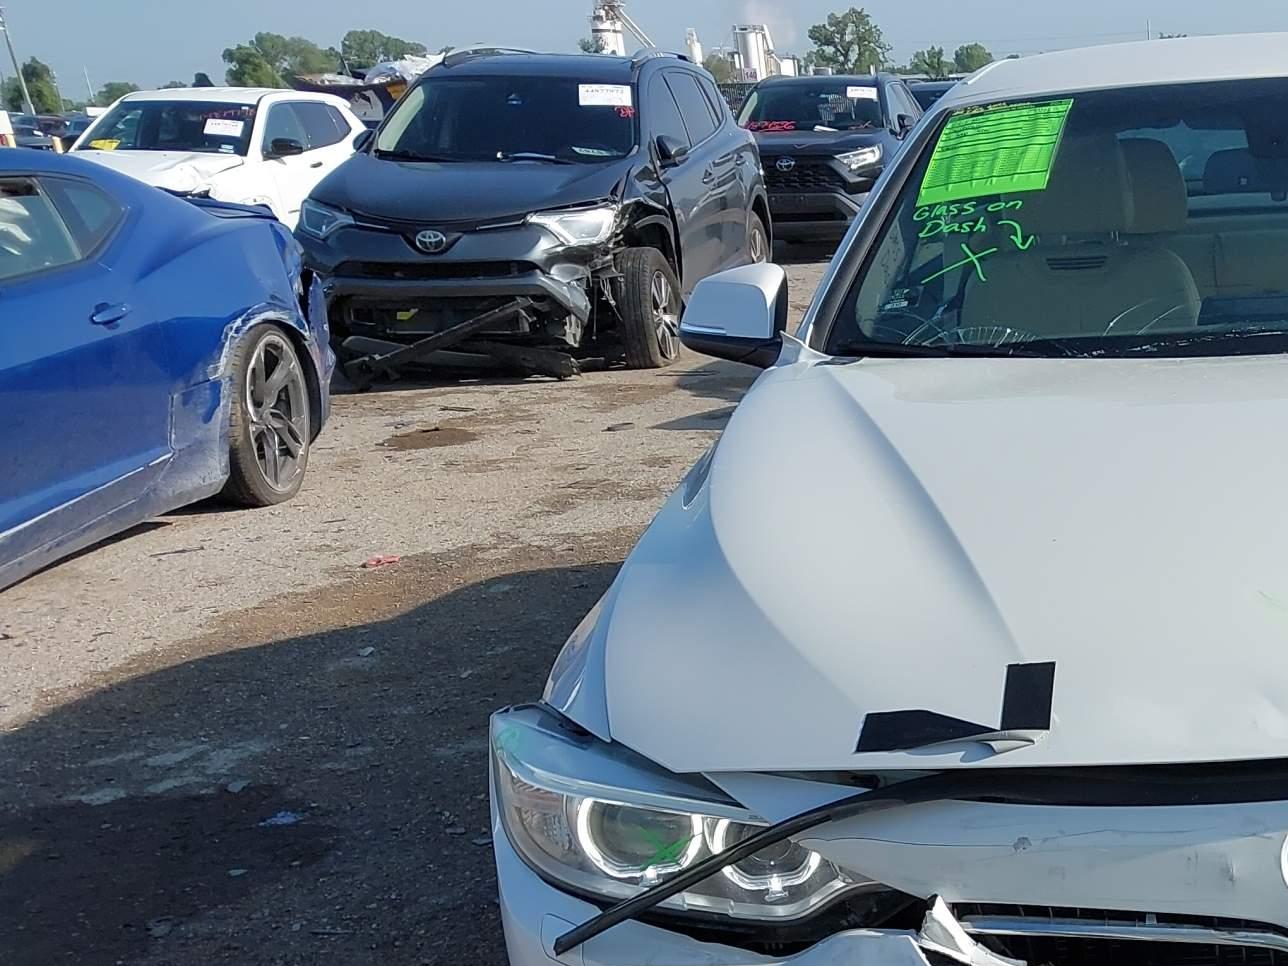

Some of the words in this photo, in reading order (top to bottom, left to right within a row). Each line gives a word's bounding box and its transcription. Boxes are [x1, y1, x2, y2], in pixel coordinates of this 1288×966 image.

[913, 201, 977, 221] Glass
[986, 199, 1023, 212] on
[918, 216, 987, 238] Dash
